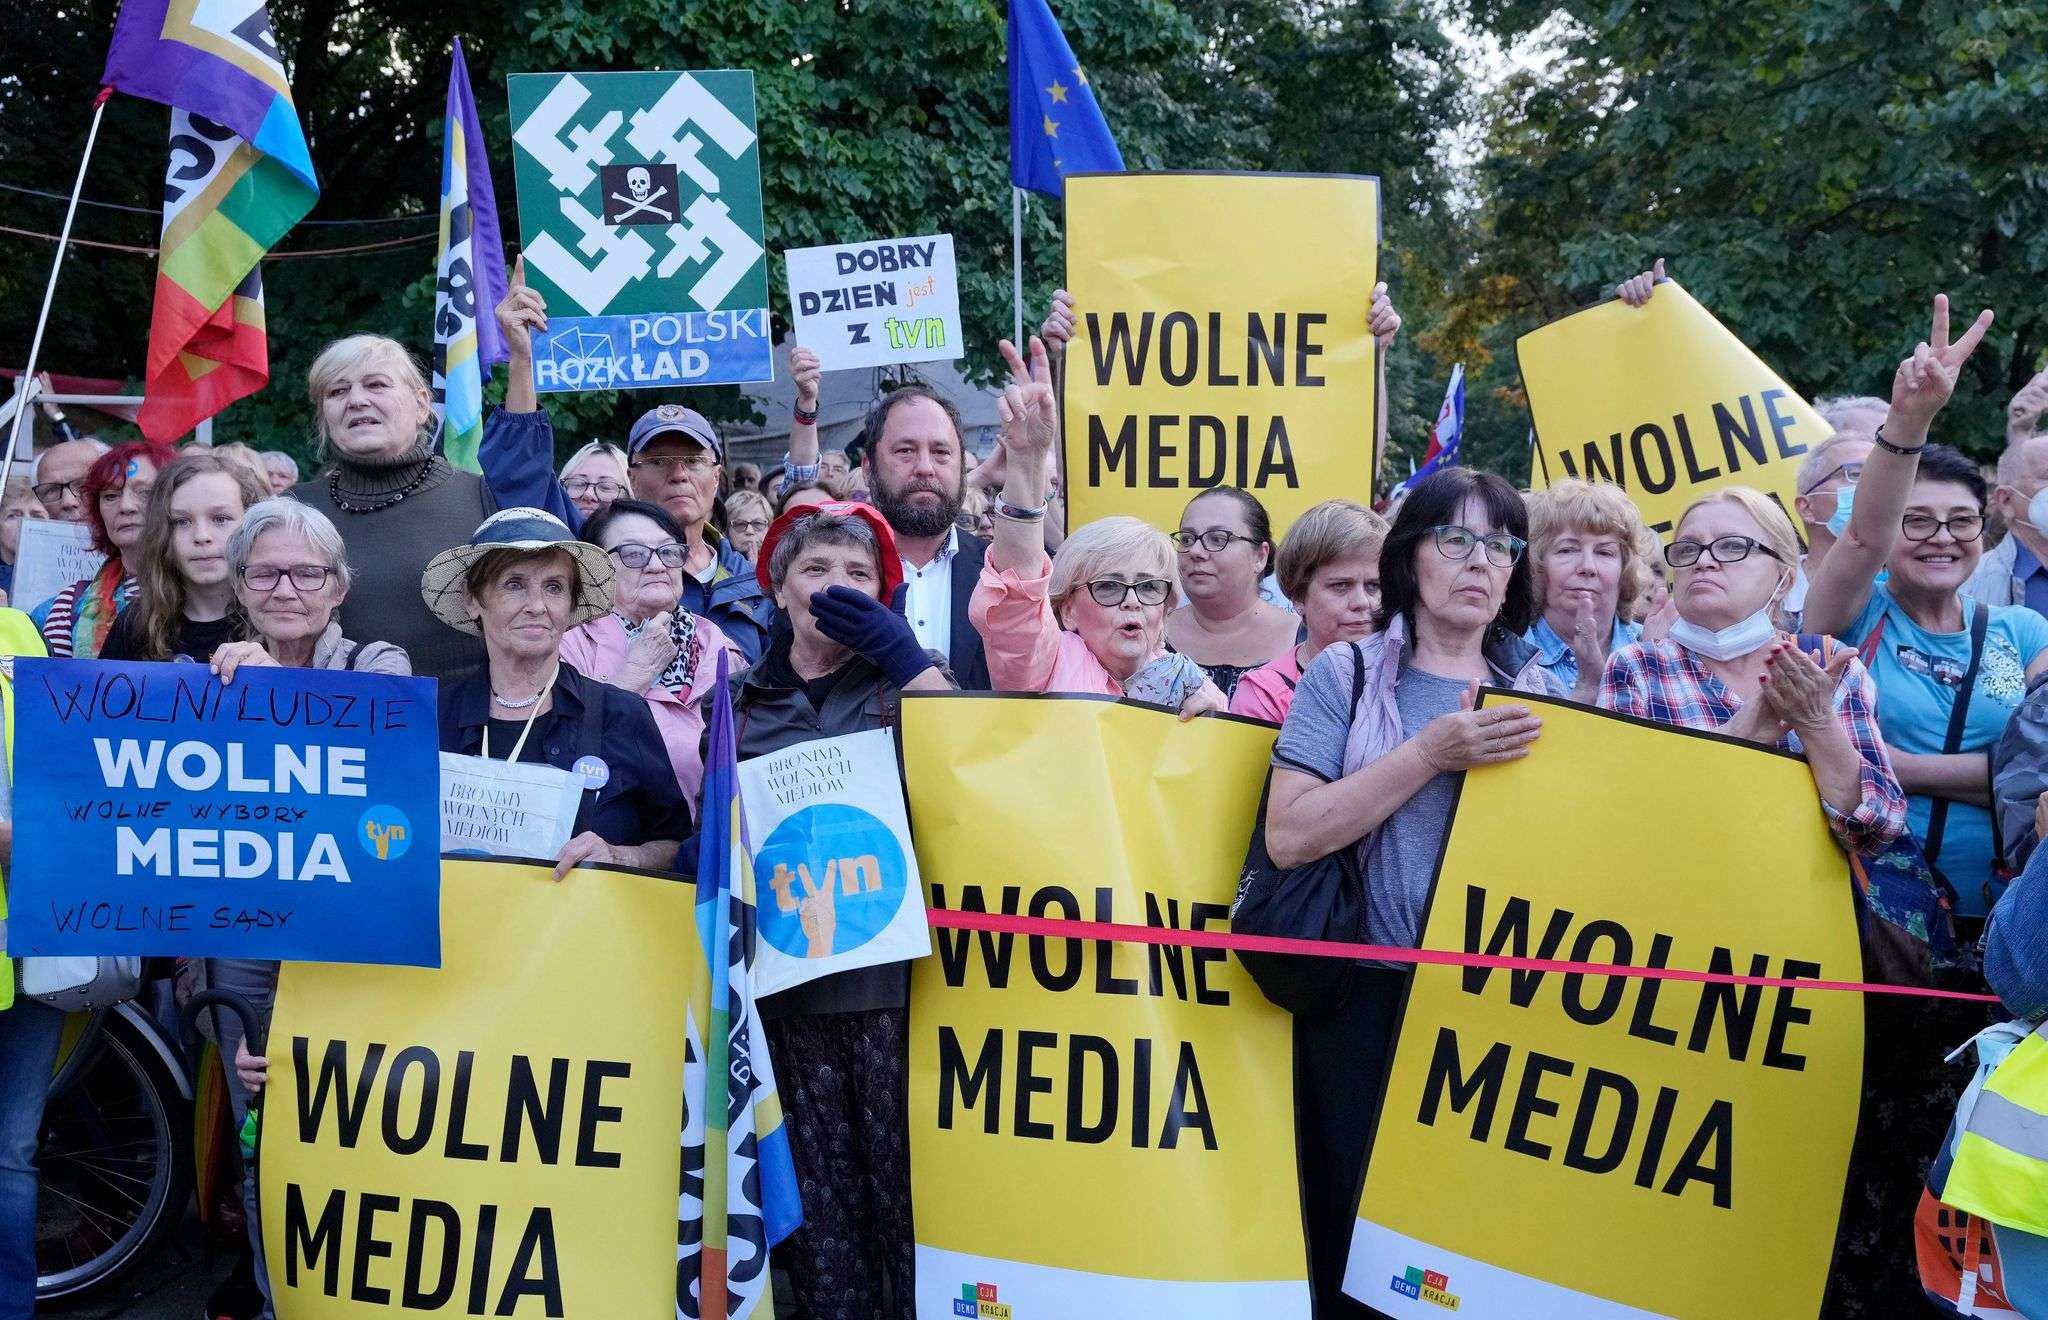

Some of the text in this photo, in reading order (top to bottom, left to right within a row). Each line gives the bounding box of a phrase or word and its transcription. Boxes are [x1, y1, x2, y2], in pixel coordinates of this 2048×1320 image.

[836, 242, 936, 275] DOBRY
[799, 276, 935, 316] DZIEŃ jest
[630, 309, 768, 349] POLSKI
[885, 317, 945, 349] tvn
[1086, 311, 1328, 387] WOLNE
[536, 349, 710, 386] ROZKŁAD
[1089, 414, 1300, 489] MEDIA
[1559, 389, 1808, 494] WOLNE
[42, 672, 414, 736] WOLNI LUDZIE
[93, 737, 368, 797] WOLNE
[64, 801, 308, 824] WOLNE WYBORY
[116, 826, 352, 883] MEDIA
[769, 854, 882, 918] tvn
[51, 900, 195, 933] WOLNE
[931, 883, 1231, 1006] WOLNE
[1462, 884, 1821, 1072] WOLNE
[292, 1036, 632, 1168] WOLNE
[938, 1025, 1219, 1150] MEDIA
[1417, 1027, 1733, 1210] MEDIA
[285, 1182, 565, 1318] MEDIA
